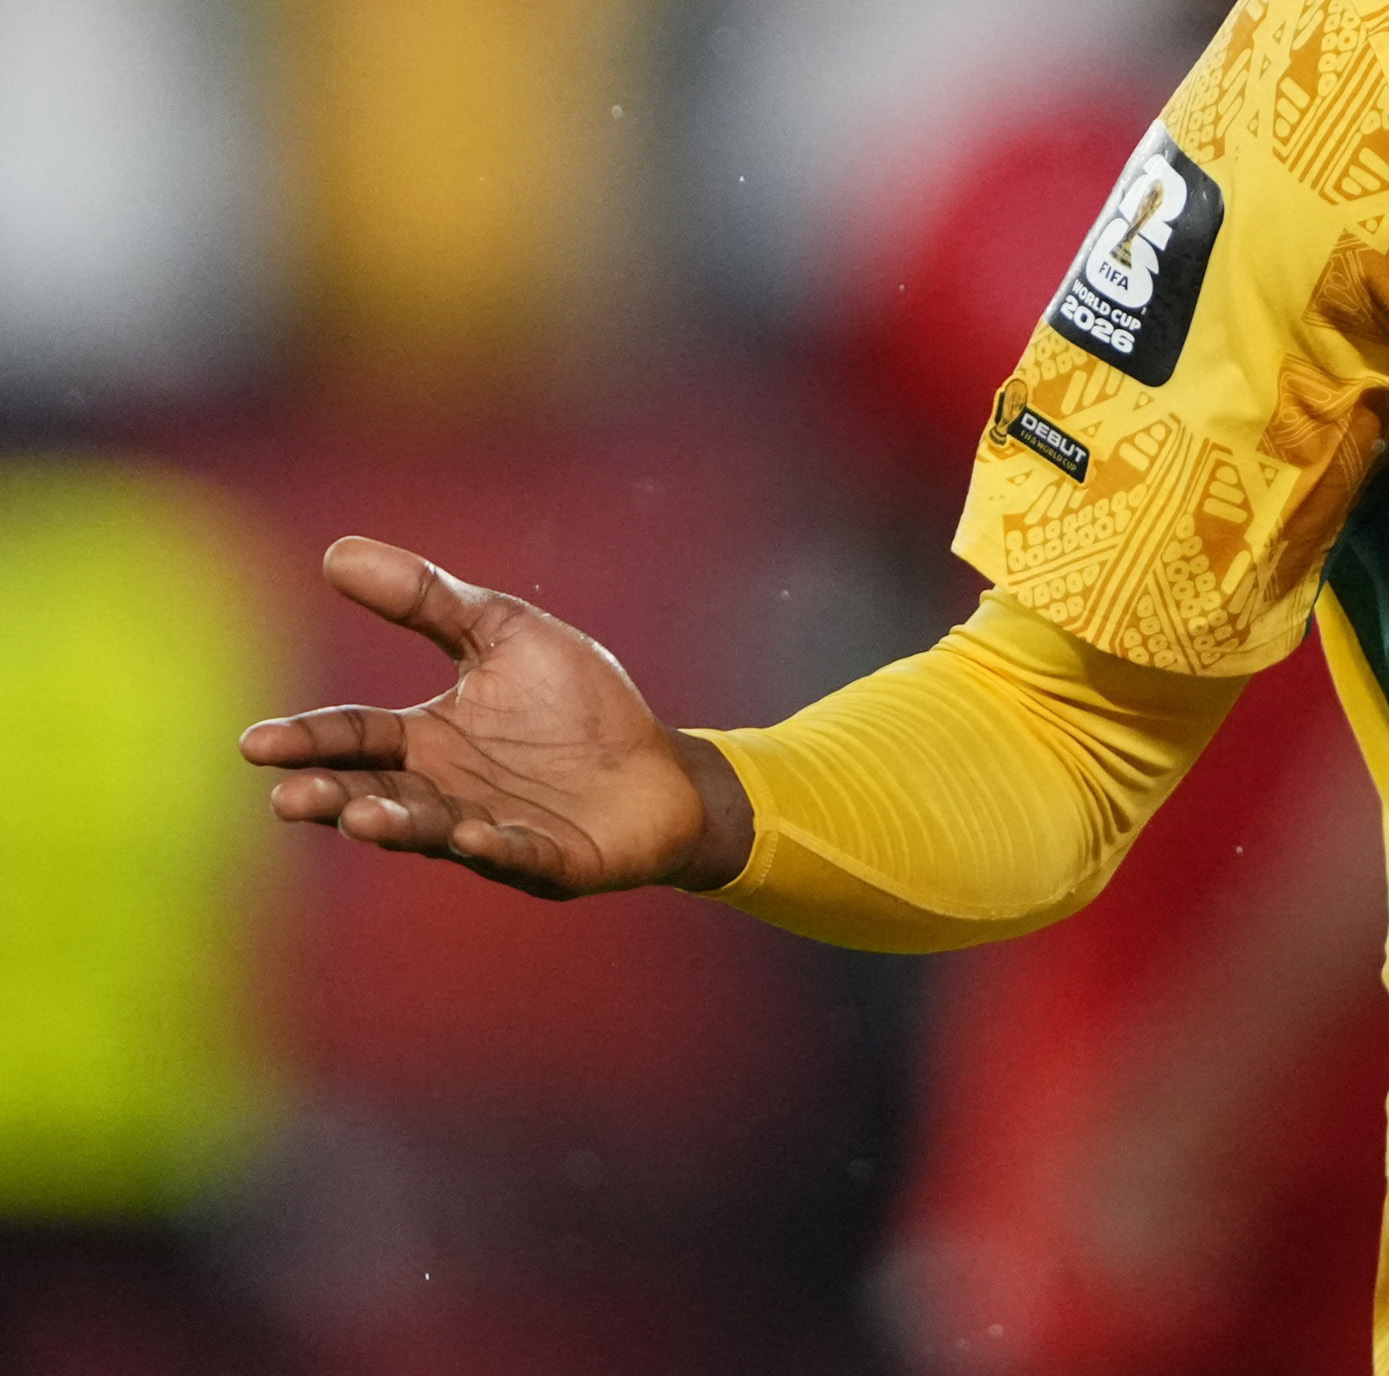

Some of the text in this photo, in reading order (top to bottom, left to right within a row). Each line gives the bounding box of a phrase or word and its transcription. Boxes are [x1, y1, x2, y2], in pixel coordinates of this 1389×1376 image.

[1098, 260, 1129, 291] FIFA
[1059, 294, 1135, 353] 2026
[1072, 279, 1142, 331] WORLD CUP
[1020, 412, 1087, 462] DEBUT
[1020, 429, 1077, 472] FIFA WORLD CUP
